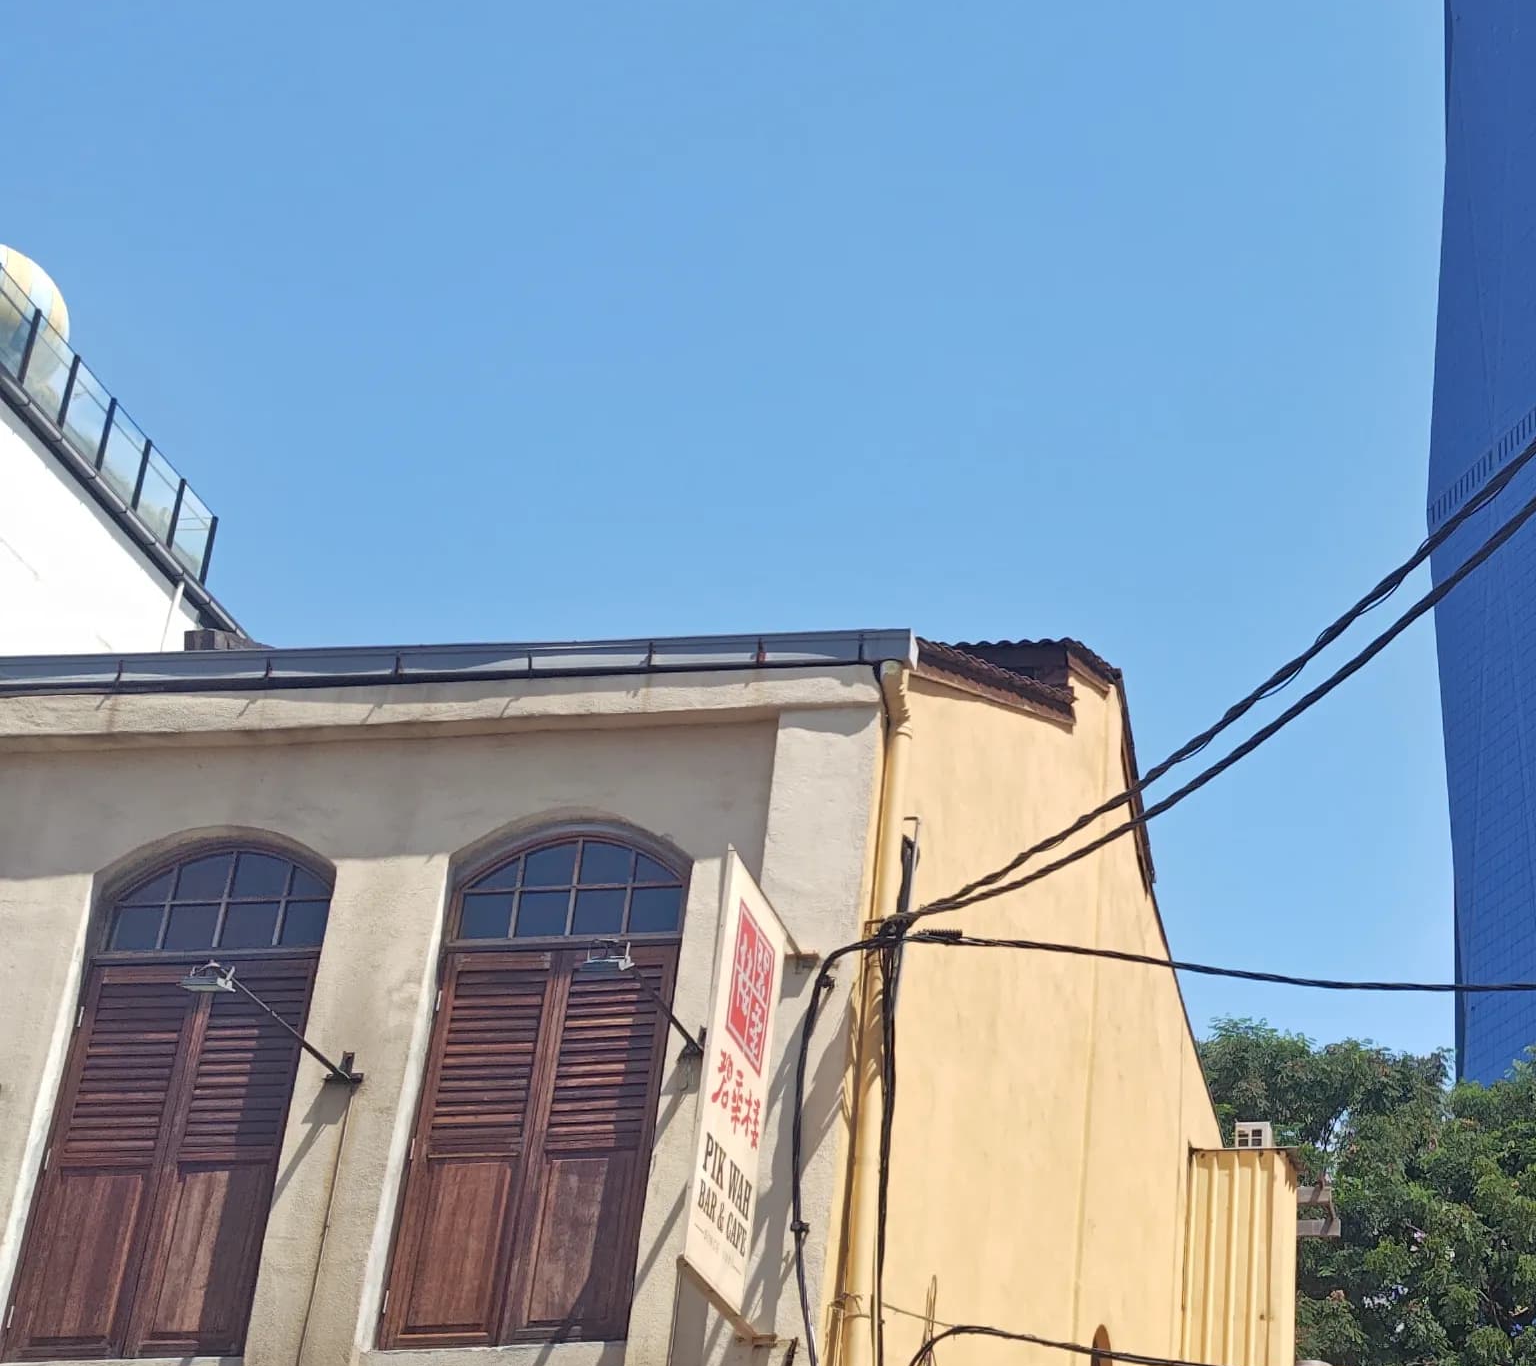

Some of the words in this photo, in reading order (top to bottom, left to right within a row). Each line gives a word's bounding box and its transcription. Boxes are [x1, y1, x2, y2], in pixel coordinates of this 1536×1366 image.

[697, 1179, 717, 1223] BAR
[717, 1202, 724, 1233] &
[726, 1211, 747, 1257] CAFE
[702, 1132, 727, 1191] PIK
[728, 1160, 752, 1221] WAH
